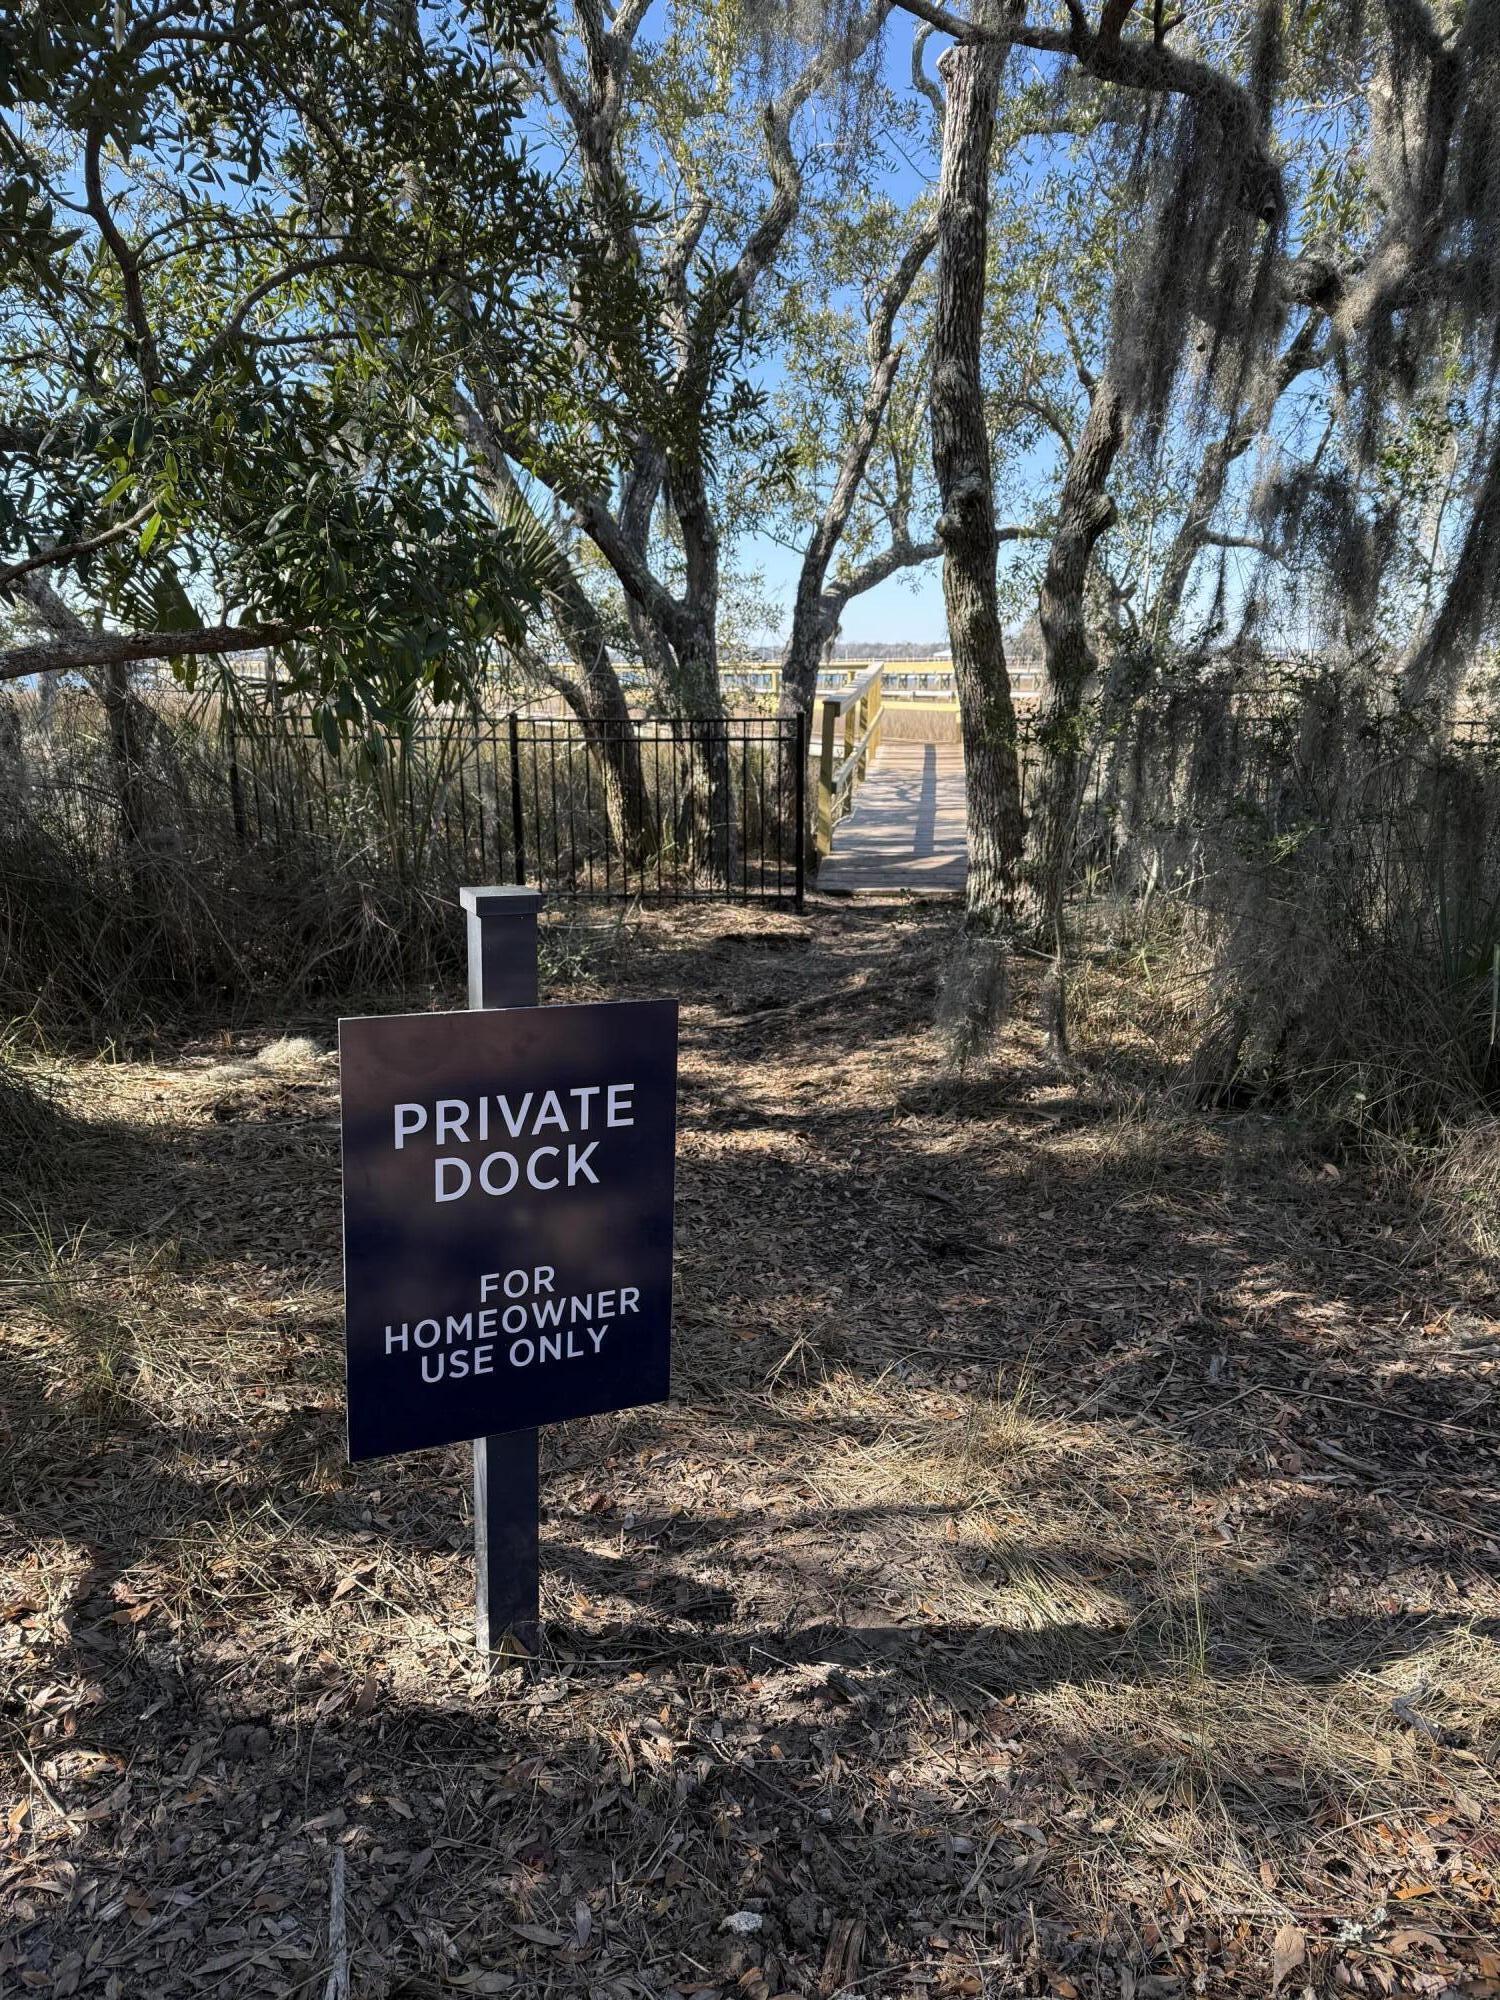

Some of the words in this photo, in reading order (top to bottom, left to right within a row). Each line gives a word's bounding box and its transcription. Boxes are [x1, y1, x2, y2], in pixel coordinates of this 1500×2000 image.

[394, 1083, 635, 1150] PRIVATE
[435, 1141, 600, 1203] DOCK
[480, 1265, 555, 1303] FOR
[385, 1287, 640, 1354] HOMEOWNER
[421, 1344, 494, 1383] USE
[509, 1325, 609, 1367] ONLY
